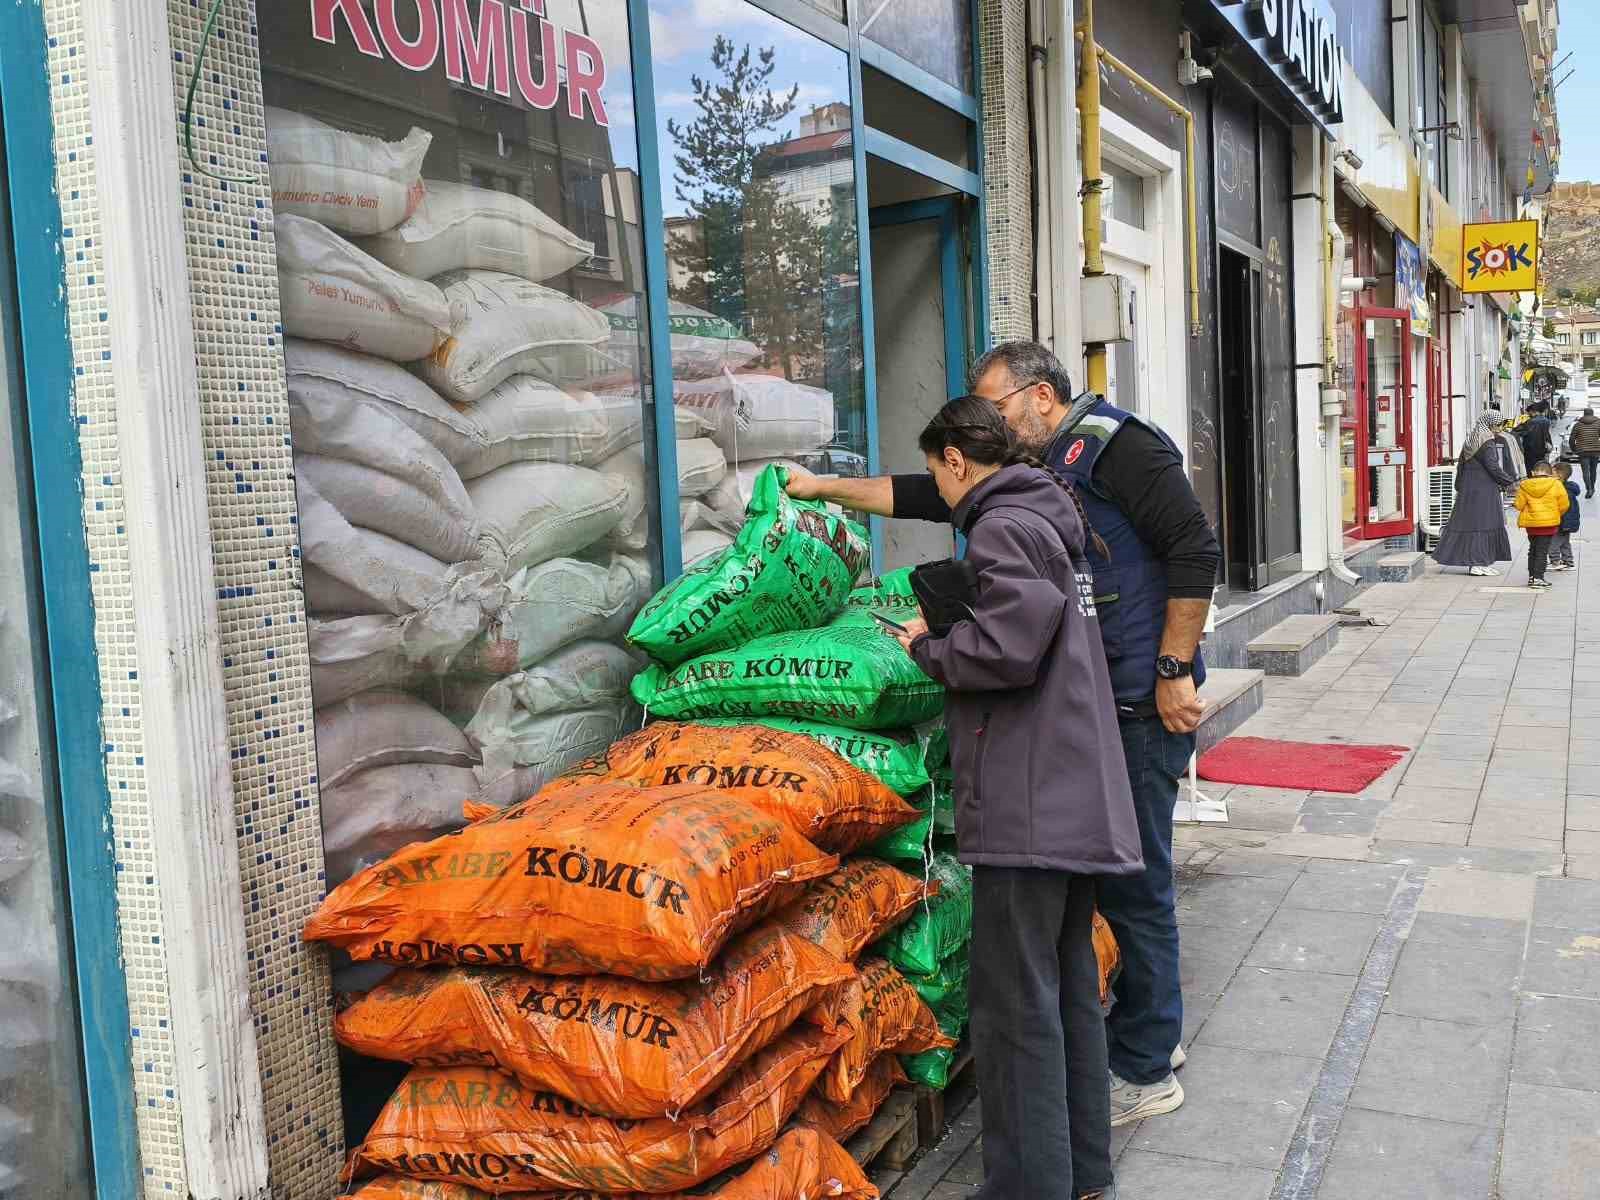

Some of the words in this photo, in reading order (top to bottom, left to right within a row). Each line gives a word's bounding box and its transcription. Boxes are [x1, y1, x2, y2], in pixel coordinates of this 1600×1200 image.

[1467, 242, 1533, 280] ŞOK
[656, 661, 734, 694] KABE
[743, 654, 854, 679] KÖMÜR
[661, 759, 809, 794] KÖMÜR
[524, 844, 690, 914] KÖMÜR
[517, 984, 678, 1049] KÖMÜR
[400, 1079, 521, 1108] KABE
